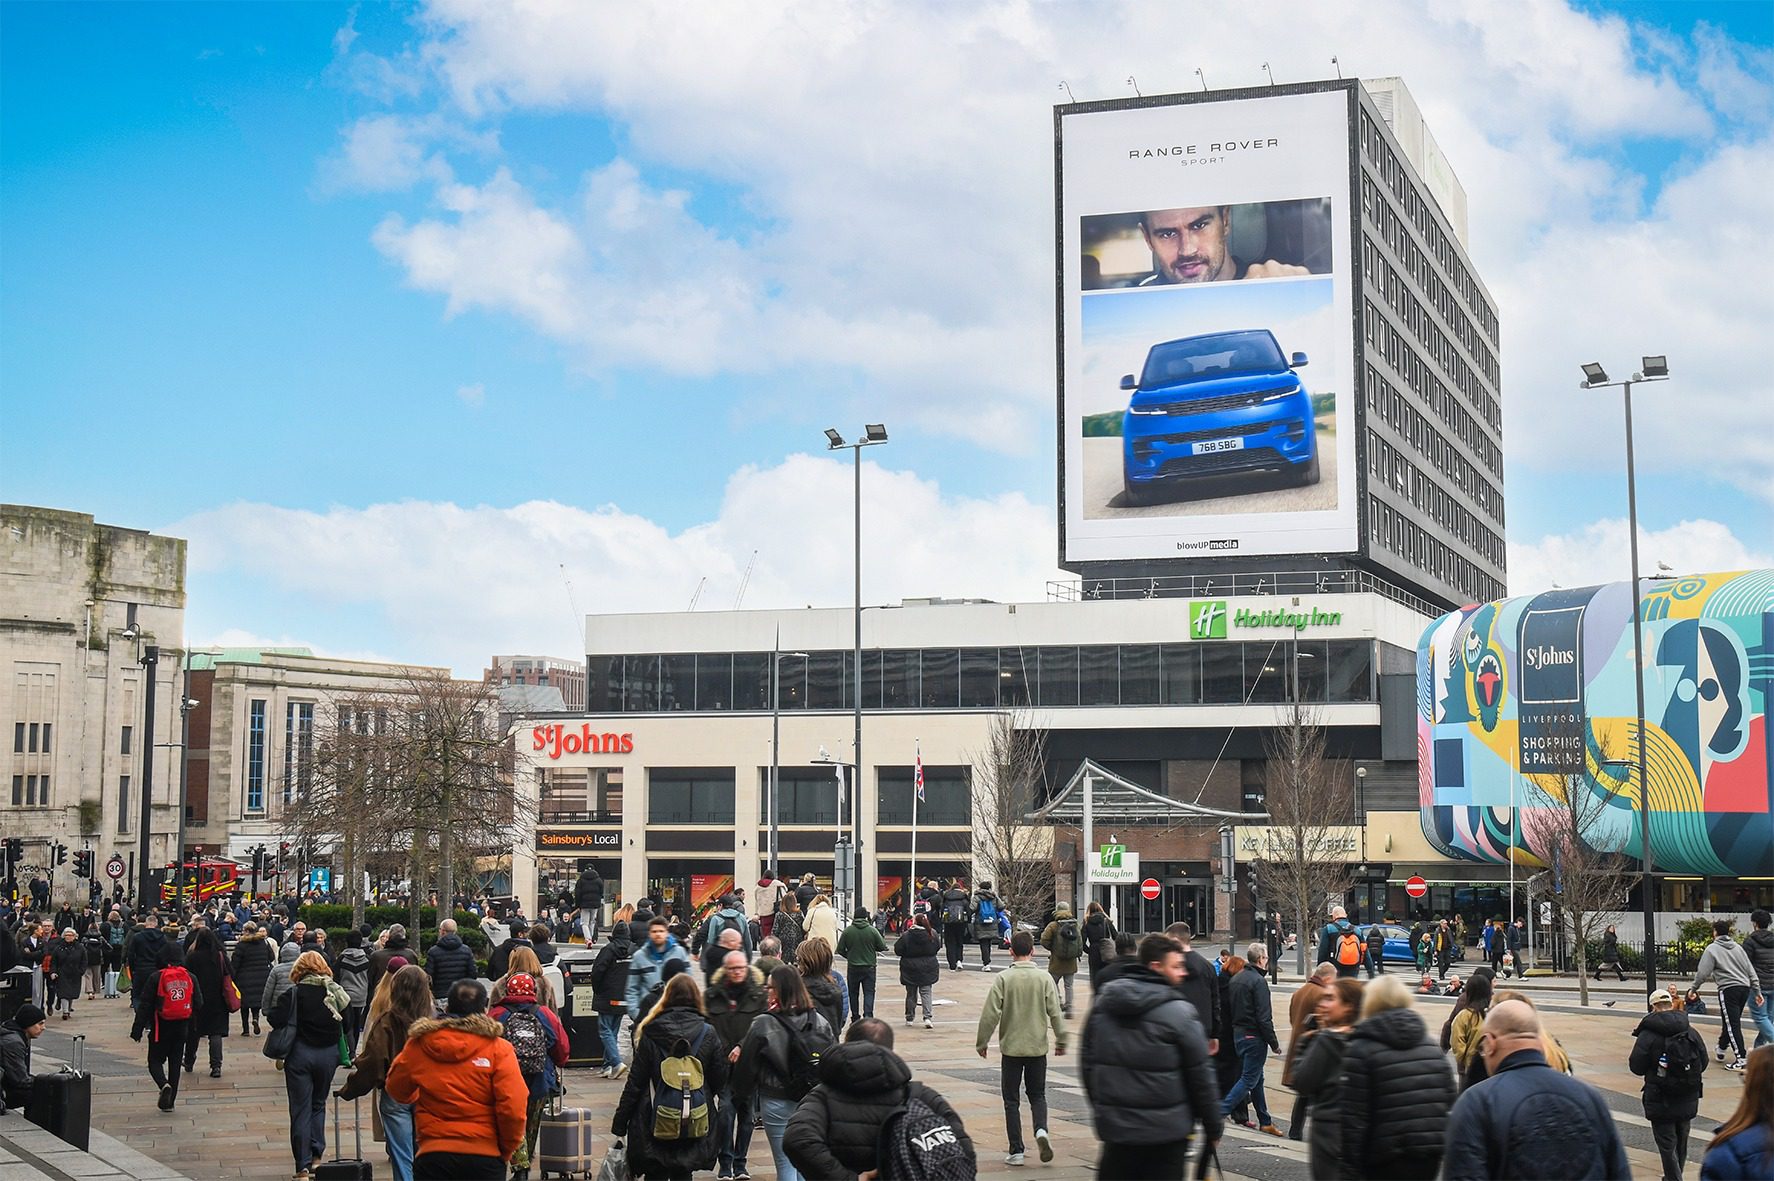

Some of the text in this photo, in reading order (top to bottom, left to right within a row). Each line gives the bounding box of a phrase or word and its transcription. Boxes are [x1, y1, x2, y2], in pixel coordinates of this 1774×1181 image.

[1129, 138, 1279, 159] RANGE ROVER
[1181, 156, 1225, 167] SPORT
[1199, 440, 1237, 452] 768 SBG
[1234, 606, 1342, 631] Holiday Inn
[1522, 714, 1581, 723] LIVERPOOL
[1522, 736, 1581, 749] SHOPPING
[1523, 751, 1582, 765] & PARKING
[541, 833, 619, 846] Sainsbury's Local
[1306, 836, 1357, 852] COFFEE
[109, 864, 121, 872] 30
[1091, 868, 1134, 879] Holiday Inn
[170, 988, 186, 1001] 23
[910, 1125, 957, 1152] VANS
